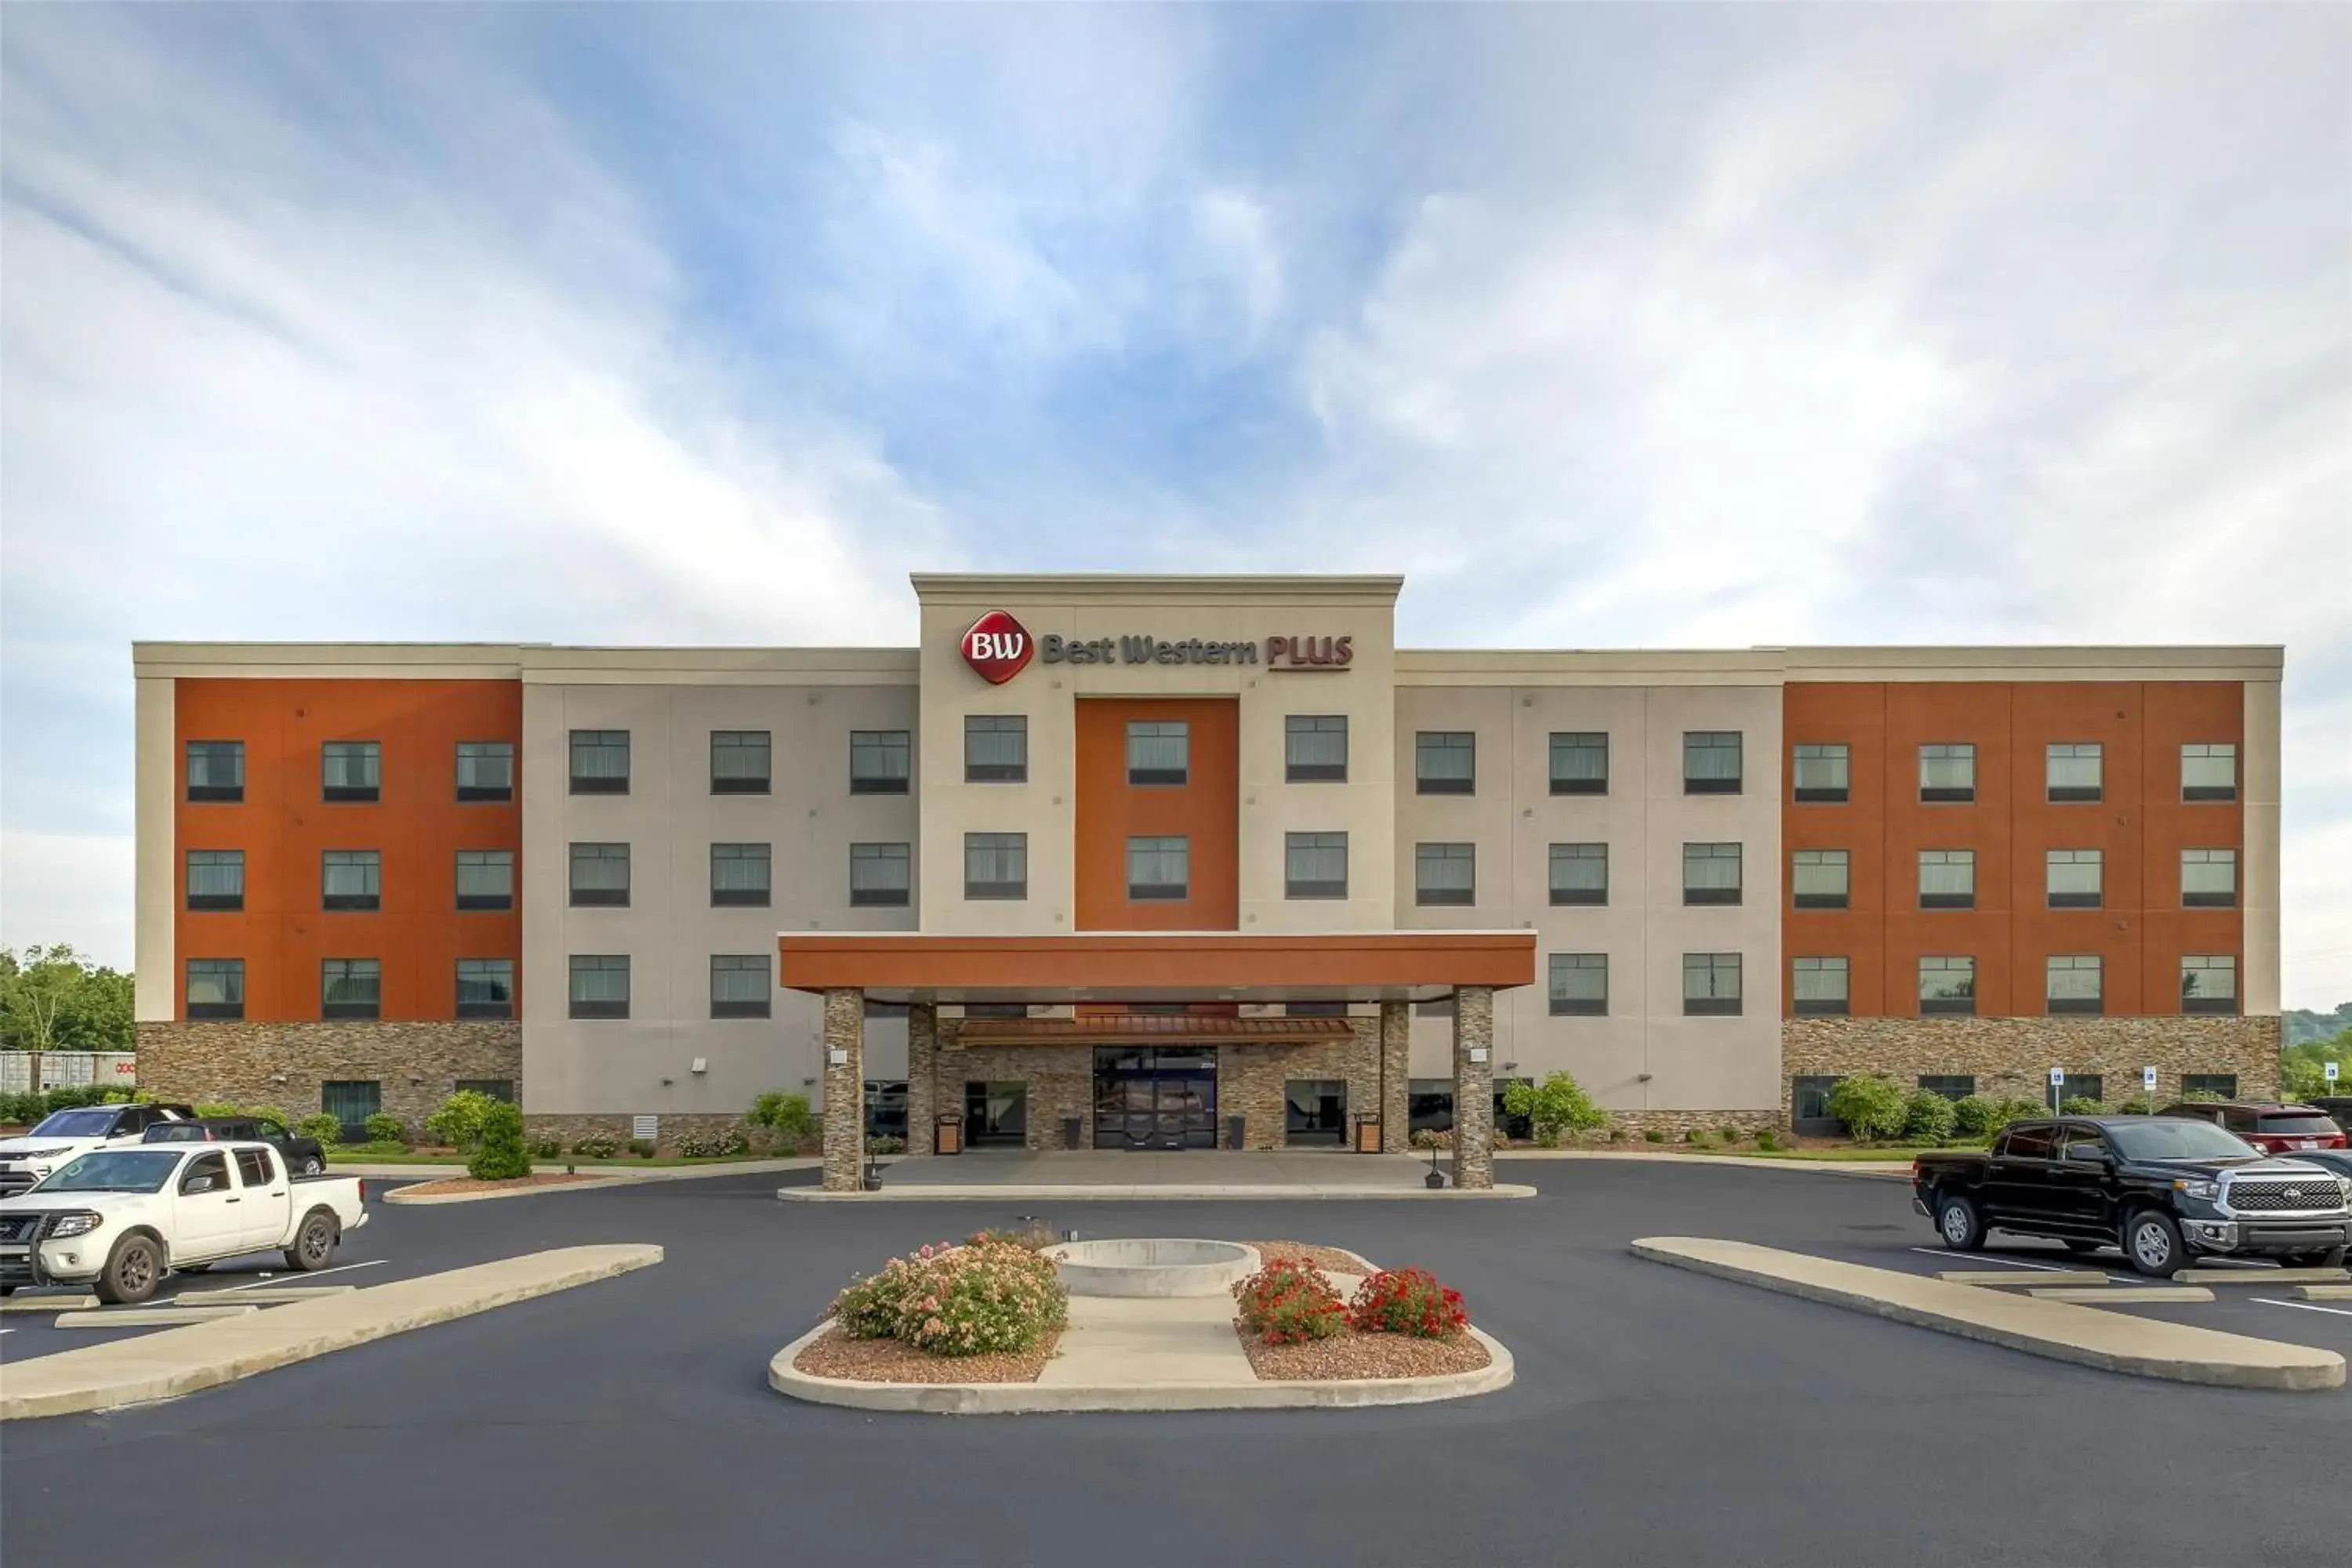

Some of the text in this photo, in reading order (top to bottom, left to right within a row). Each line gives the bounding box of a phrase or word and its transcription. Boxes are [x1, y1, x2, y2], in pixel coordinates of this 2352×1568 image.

[971, 633, 1022, 659] BW
[1042, 634, 1353, 665] Best Western PLUS
